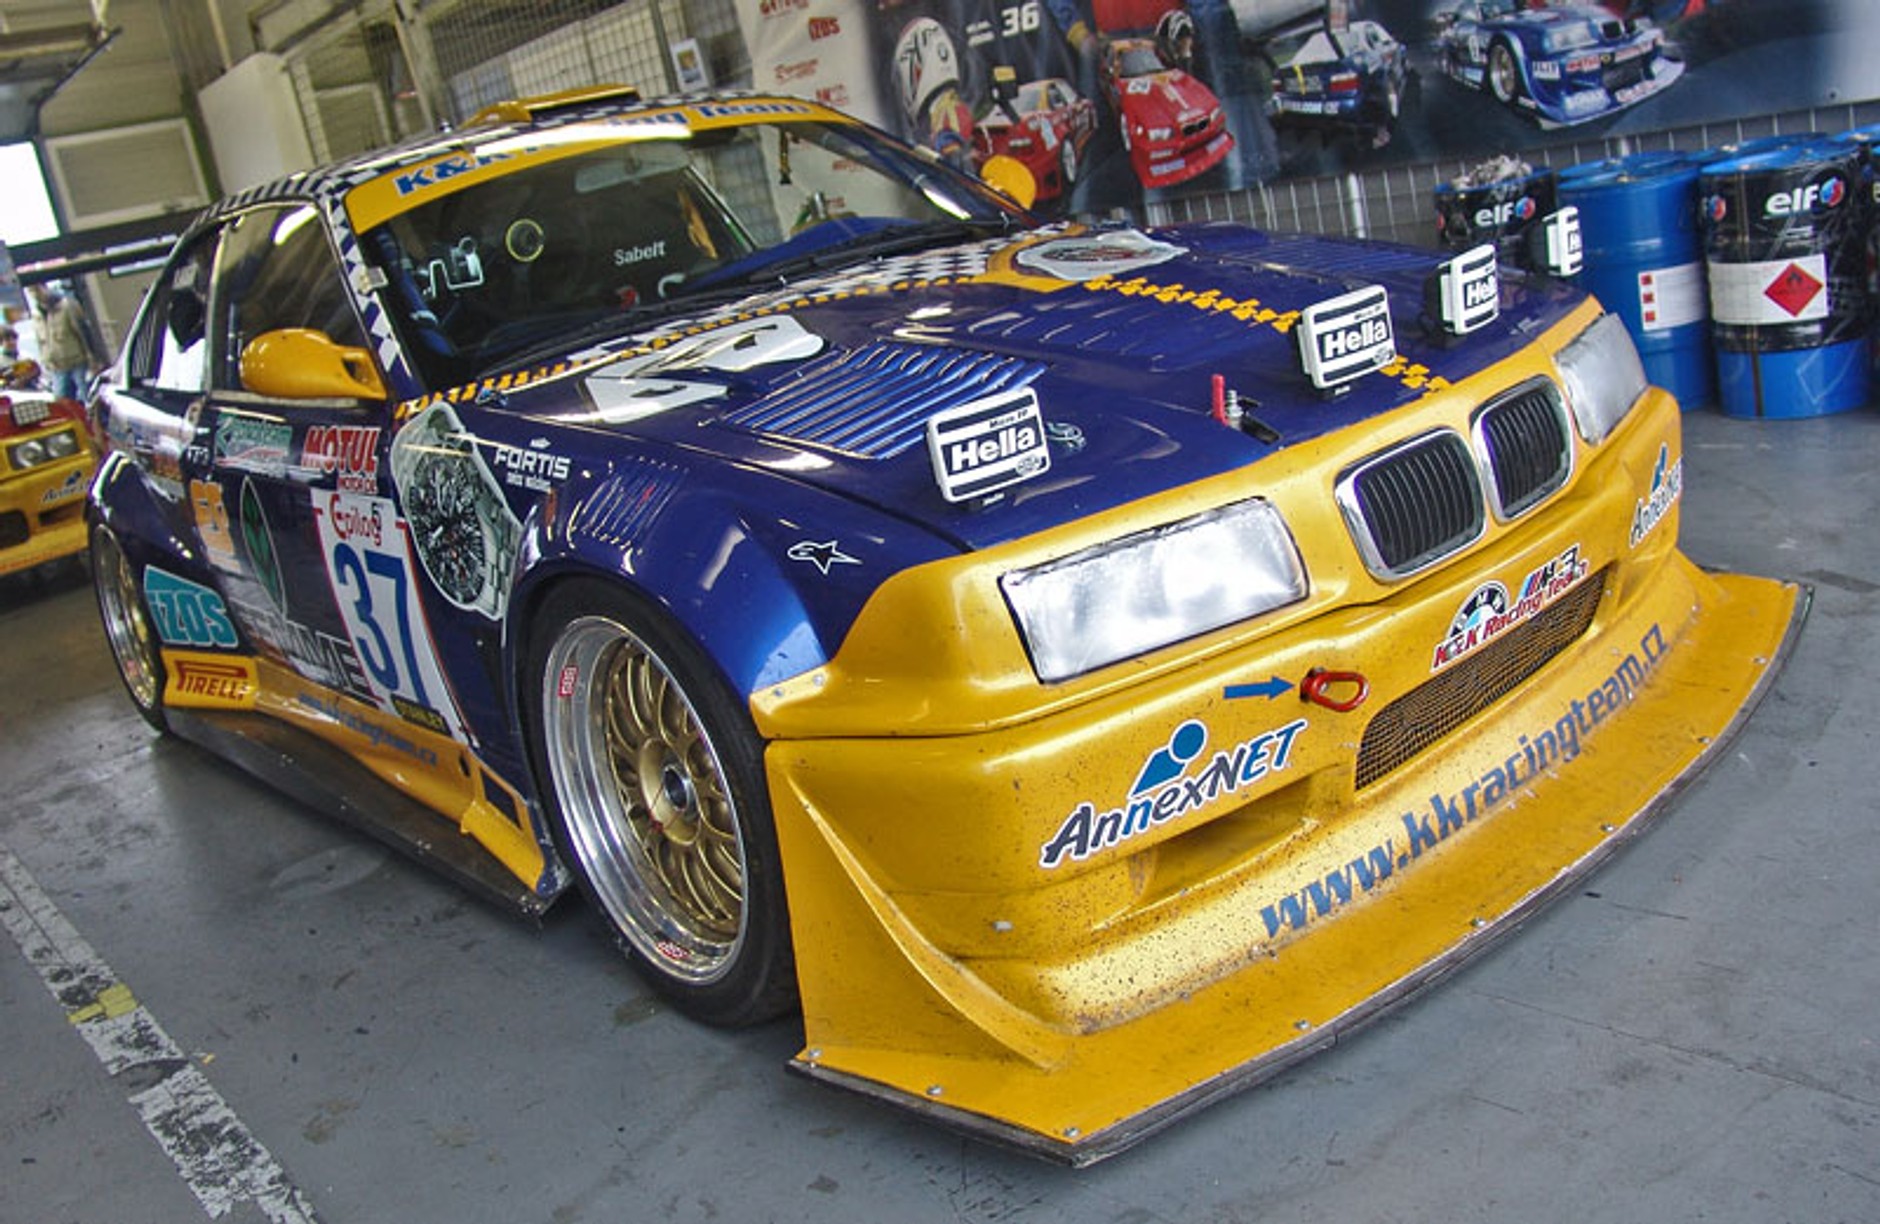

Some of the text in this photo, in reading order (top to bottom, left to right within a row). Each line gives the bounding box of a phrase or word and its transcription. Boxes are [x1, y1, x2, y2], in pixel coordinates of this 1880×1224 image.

[1001, 1, 1041, 38] 36
[1475, 202, 1514, 227] elf
[1765, 184, 1819, 215] elf
[614, 240, 666, 267] Sabelt
[1324, 319, 1387, 358] Hella
[302, 426, 381, 473] MOTUL
[494, 447, 571, 479] FORTIS
[951, 426, 1037, 472] Hella
[334, 542, 432, 707] 37
[1482, 592, 1544, 640] Racing
[1041, 719, 1307, 867] AnnexNET
[1260, 622, 1670, 938] www.kkracingteam.cz
